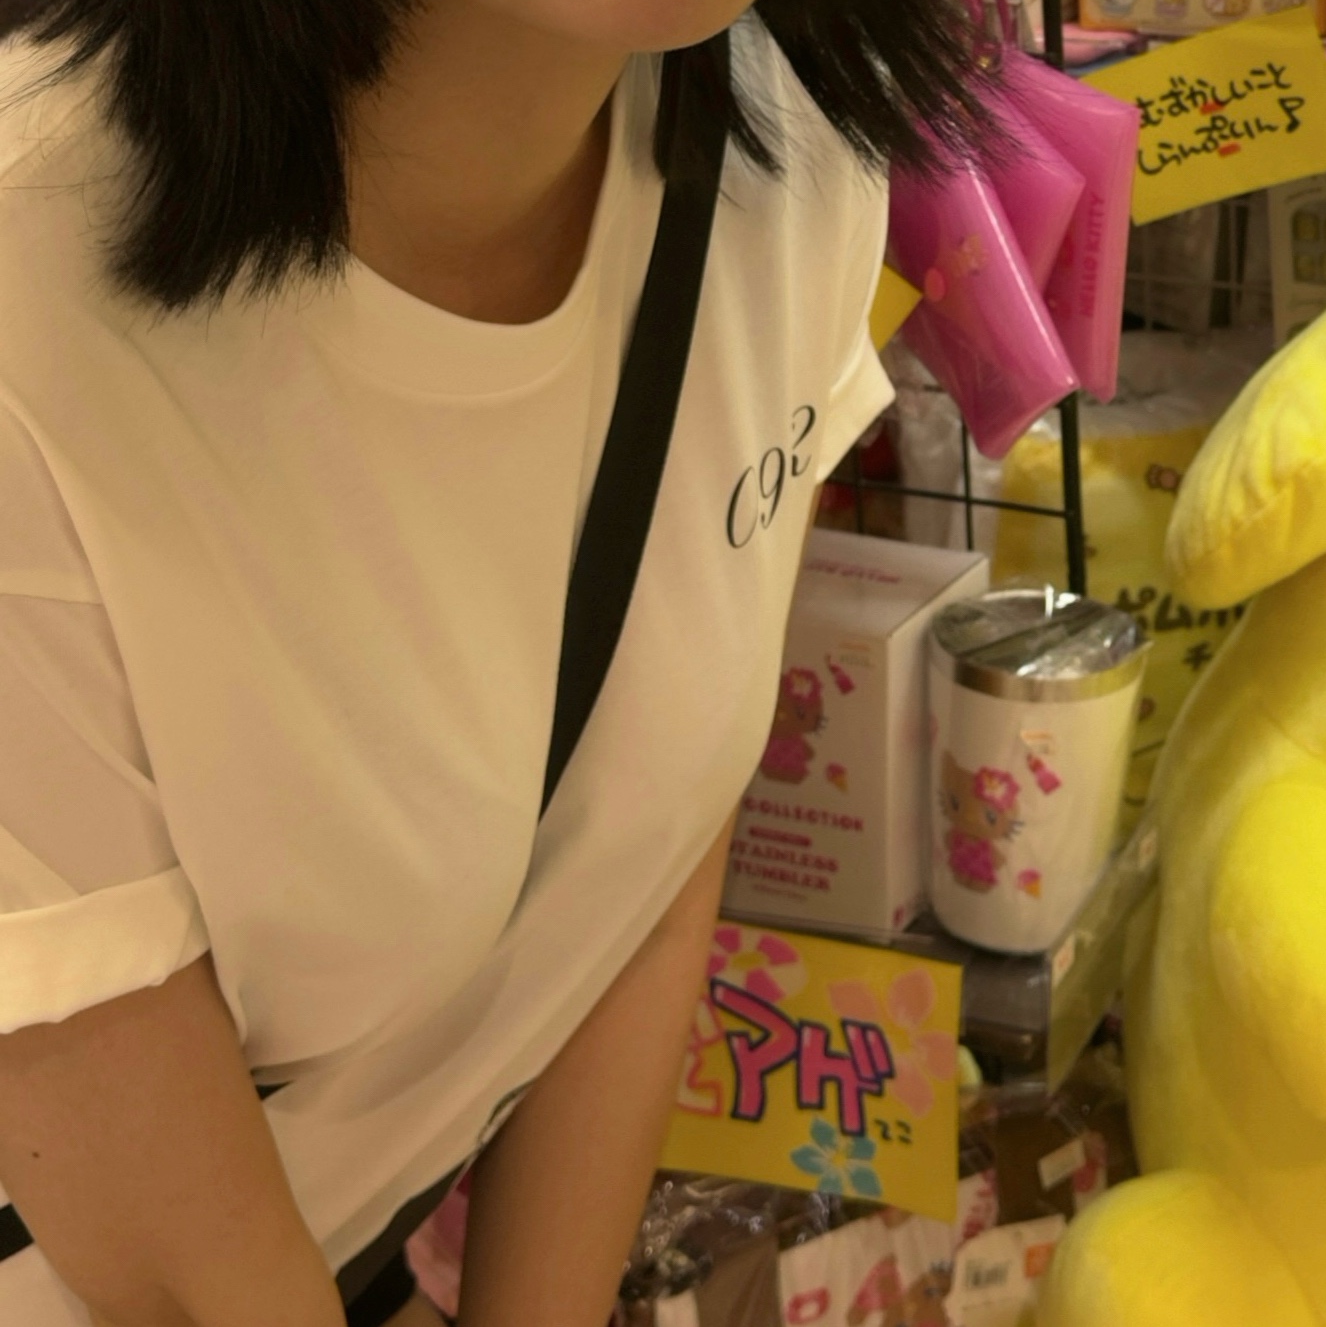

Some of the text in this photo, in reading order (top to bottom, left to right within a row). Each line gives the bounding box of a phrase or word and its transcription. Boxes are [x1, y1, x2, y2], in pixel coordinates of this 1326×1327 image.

[1136, 62, 1292, 129] むずかしいこと
[743, 795, 863, 833] COLLECTION
